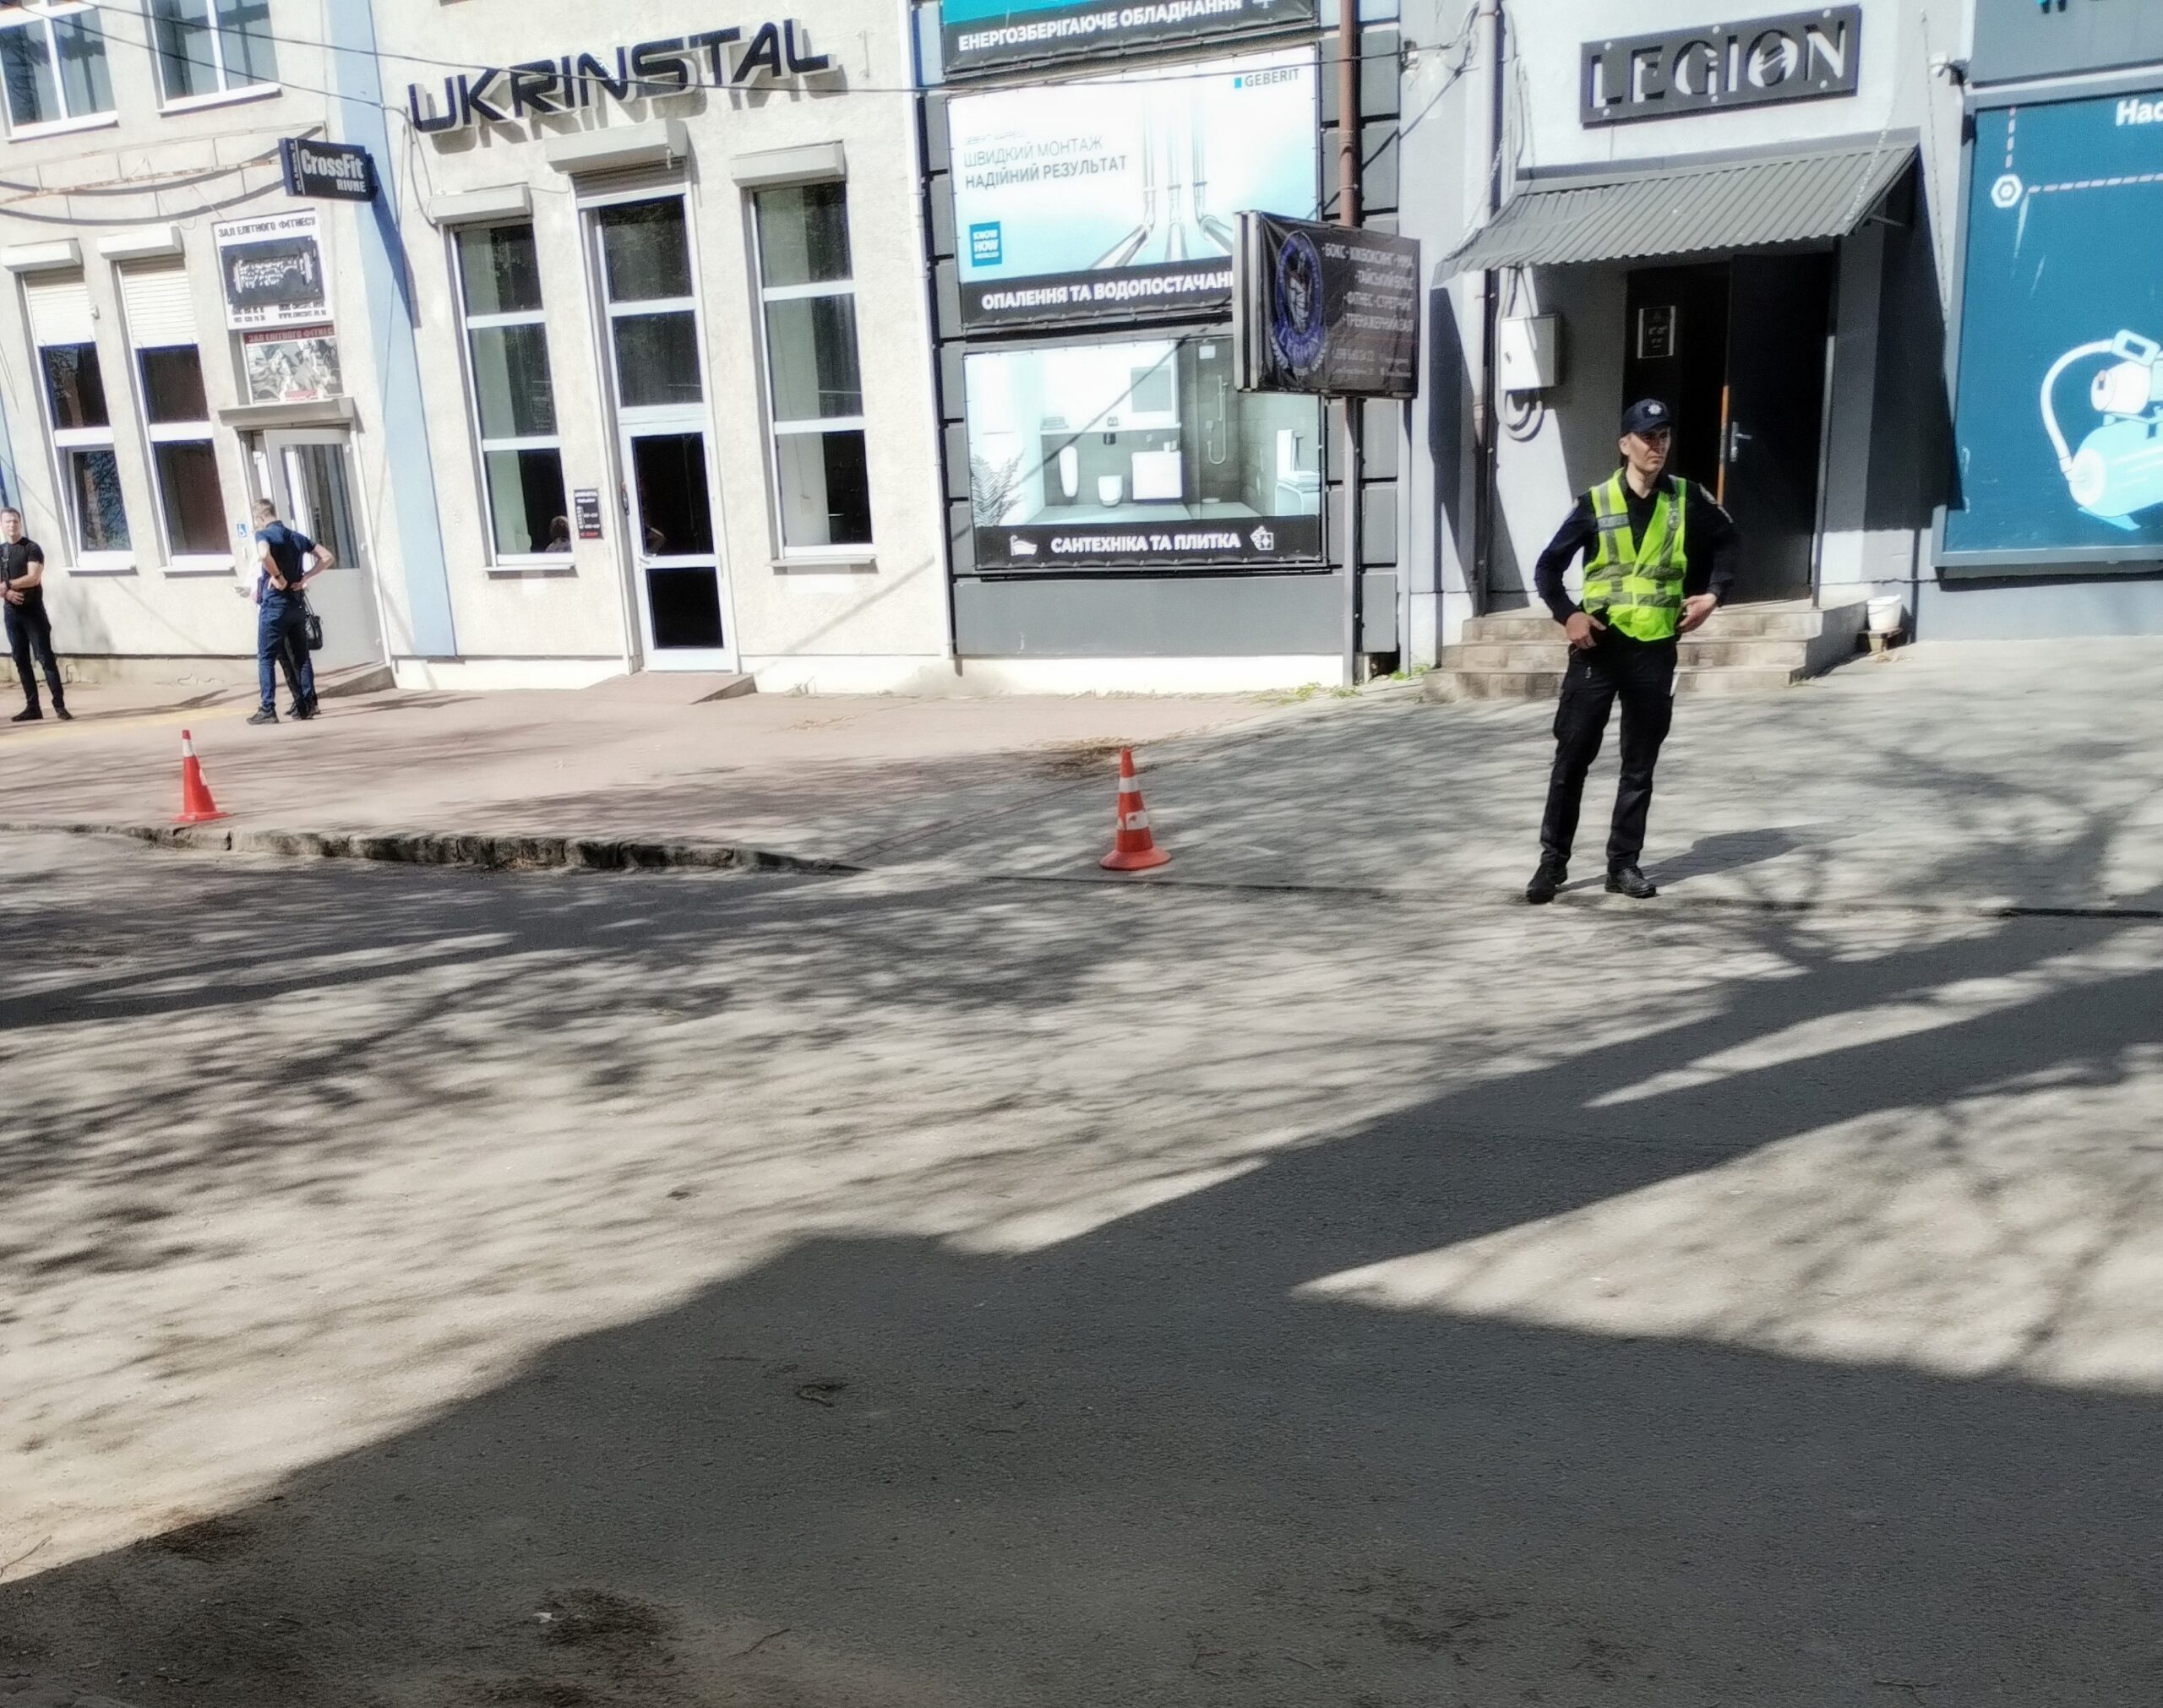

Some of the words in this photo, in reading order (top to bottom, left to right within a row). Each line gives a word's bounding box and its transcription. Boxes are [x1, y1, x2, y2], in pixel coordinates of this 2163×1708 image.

[958, 11, 1118, 52] ЕНЕРГОЗБЕРІГАЮЧЕ
[1120, 0, 1243, 27] ОБЛАДНАННЯ
[408, 18, 836, 133] UKRINSTAL
[1245, 68, 1300, 88] GEBERIT
[1589, 20, 1847, 108] LEGION
[300, 149, 364, 180] CrossFit
[963, 141, 1034, 168] ШВИДКИЙ
[1038, 135, 1103, 157] МОНТАЖ
[335, 178, 366, 193] RIVNE
[966, 163, 1039, 190] НАДІЙНИЙ
[1043, 155, 1127, 180] РЕЗУЛЬТАТ
[218, 227, 236, 237] ЗАЛ
[982, 286, 1069, 310] ОПАЛЕННЯ
[1069, 284, 1092, 302] ТА
[1050, 536, 1148, 553] САНТЕХНІКА
[1149, 535, 1173, 552] ТА
[1174, 533, 1242, 551] ПЛИТКА
